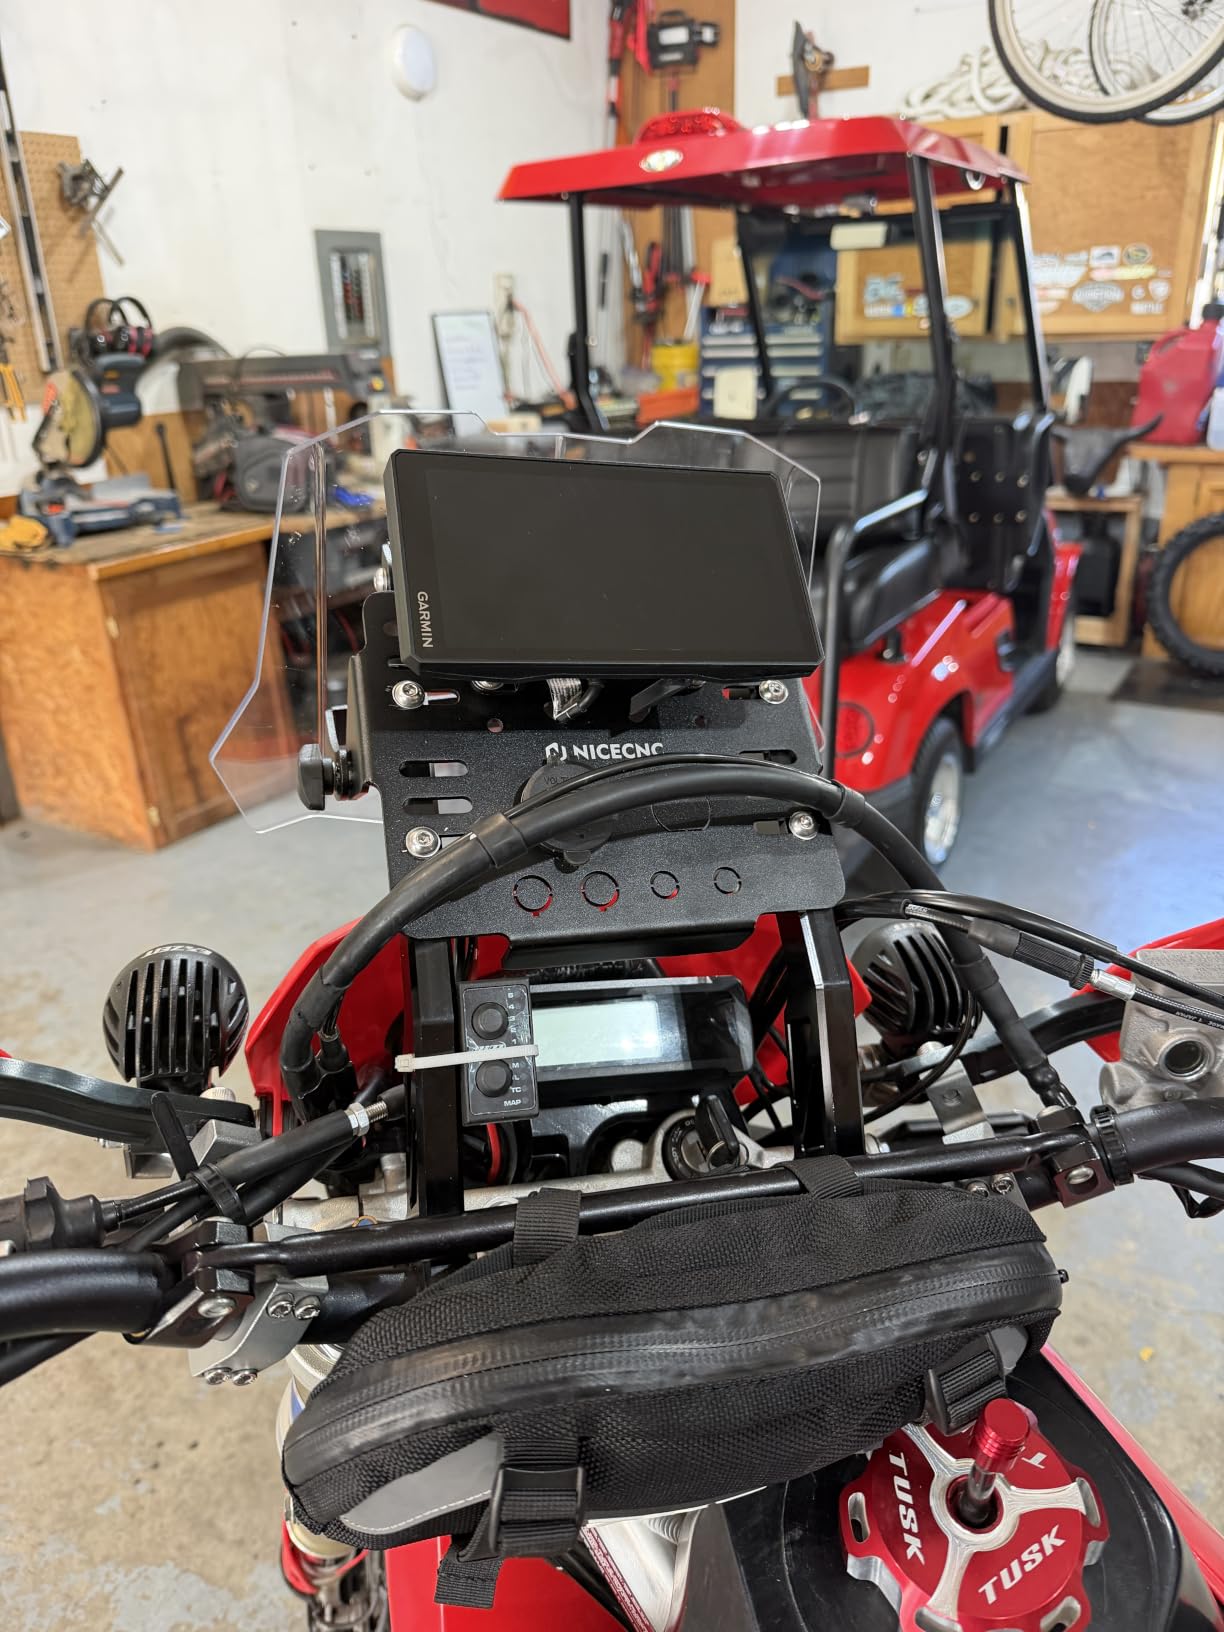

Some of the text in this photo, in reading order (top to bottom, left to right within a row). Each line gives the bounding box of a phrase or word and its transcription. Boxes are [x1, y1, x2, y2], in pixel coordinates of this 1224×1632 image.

[417, 591, 434, 648] GARMIN
[572, 742, 664, 760] NICECNC
[503, 1099, 522, 1107] MAP
[889, 1451, 926, 1566] TUSK
[977, 1524, 1066, 1605] TUSK
